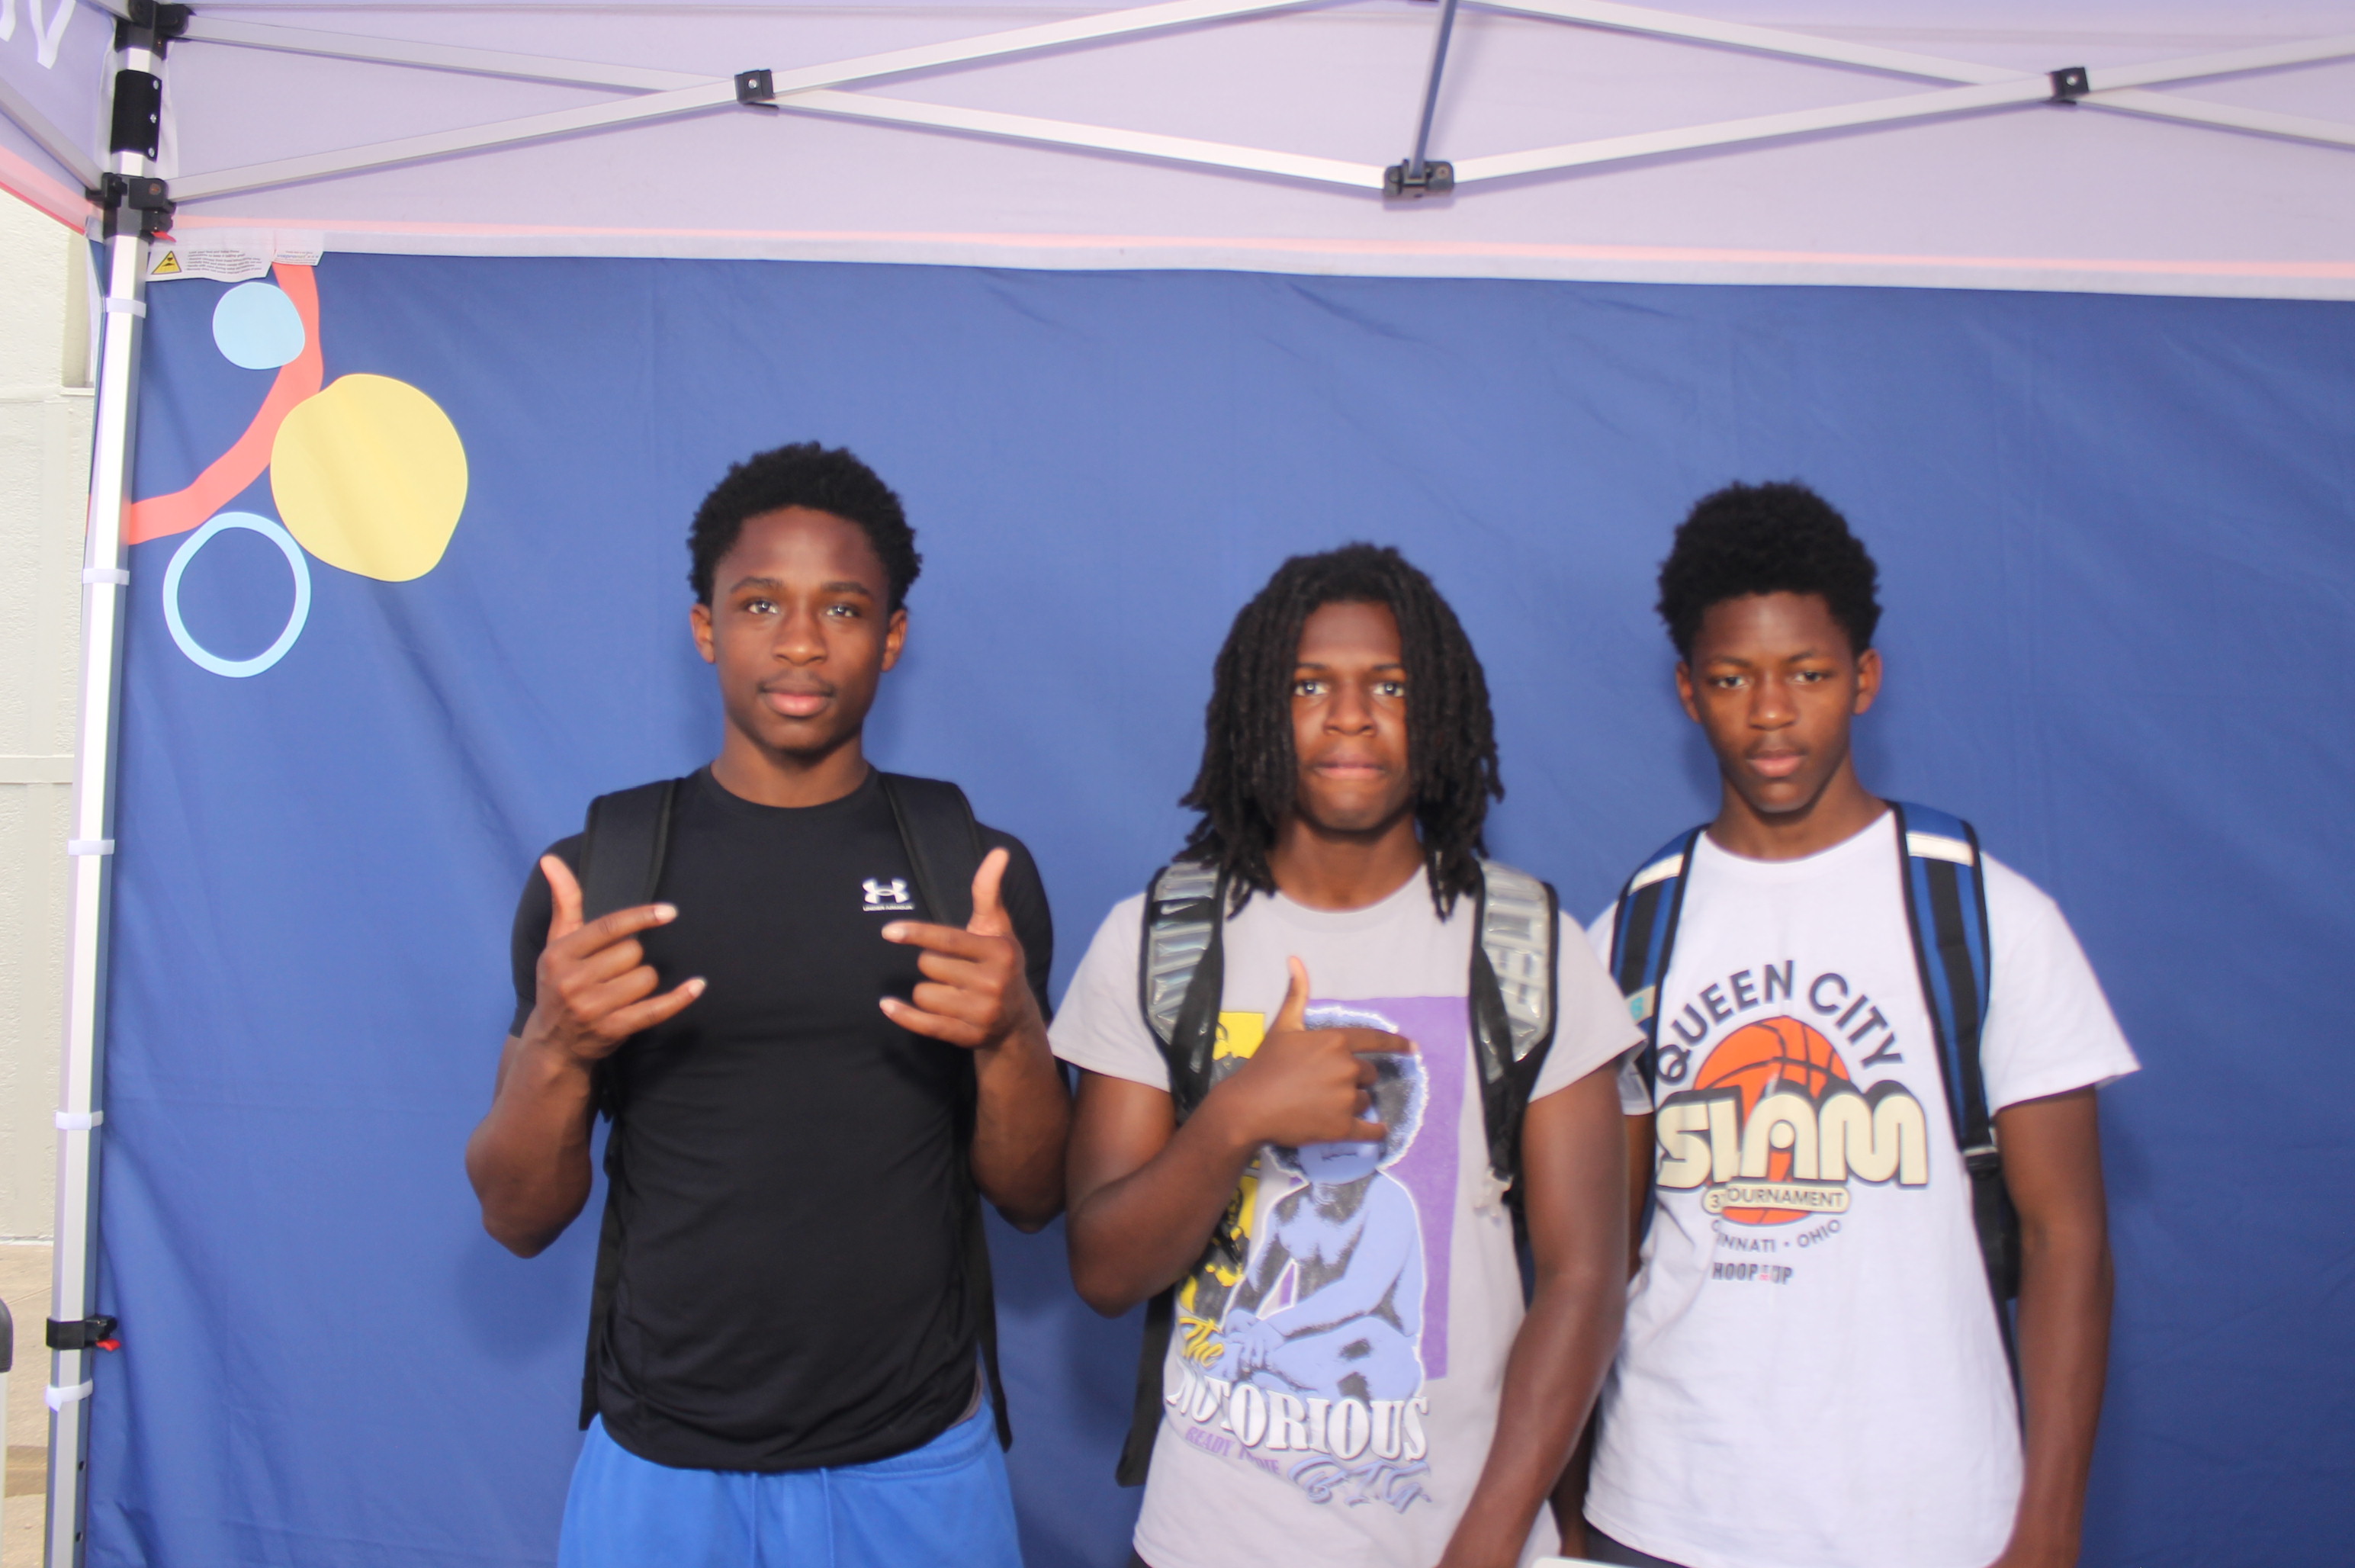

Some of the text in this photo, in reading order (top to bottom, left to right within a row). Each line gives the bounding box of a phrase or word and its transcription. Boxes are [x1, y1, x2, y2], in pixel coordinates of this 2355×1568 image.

[1656, 960, 1903, 1084] QUEEN CITY
[1656, 1081, 1929, 1192] SLAM
[1798, 1219, 1842, 1248] OHIO
[1712, 1262, 1759, 1281] HOOP
[1178, 1317, 1225, 1368] The
